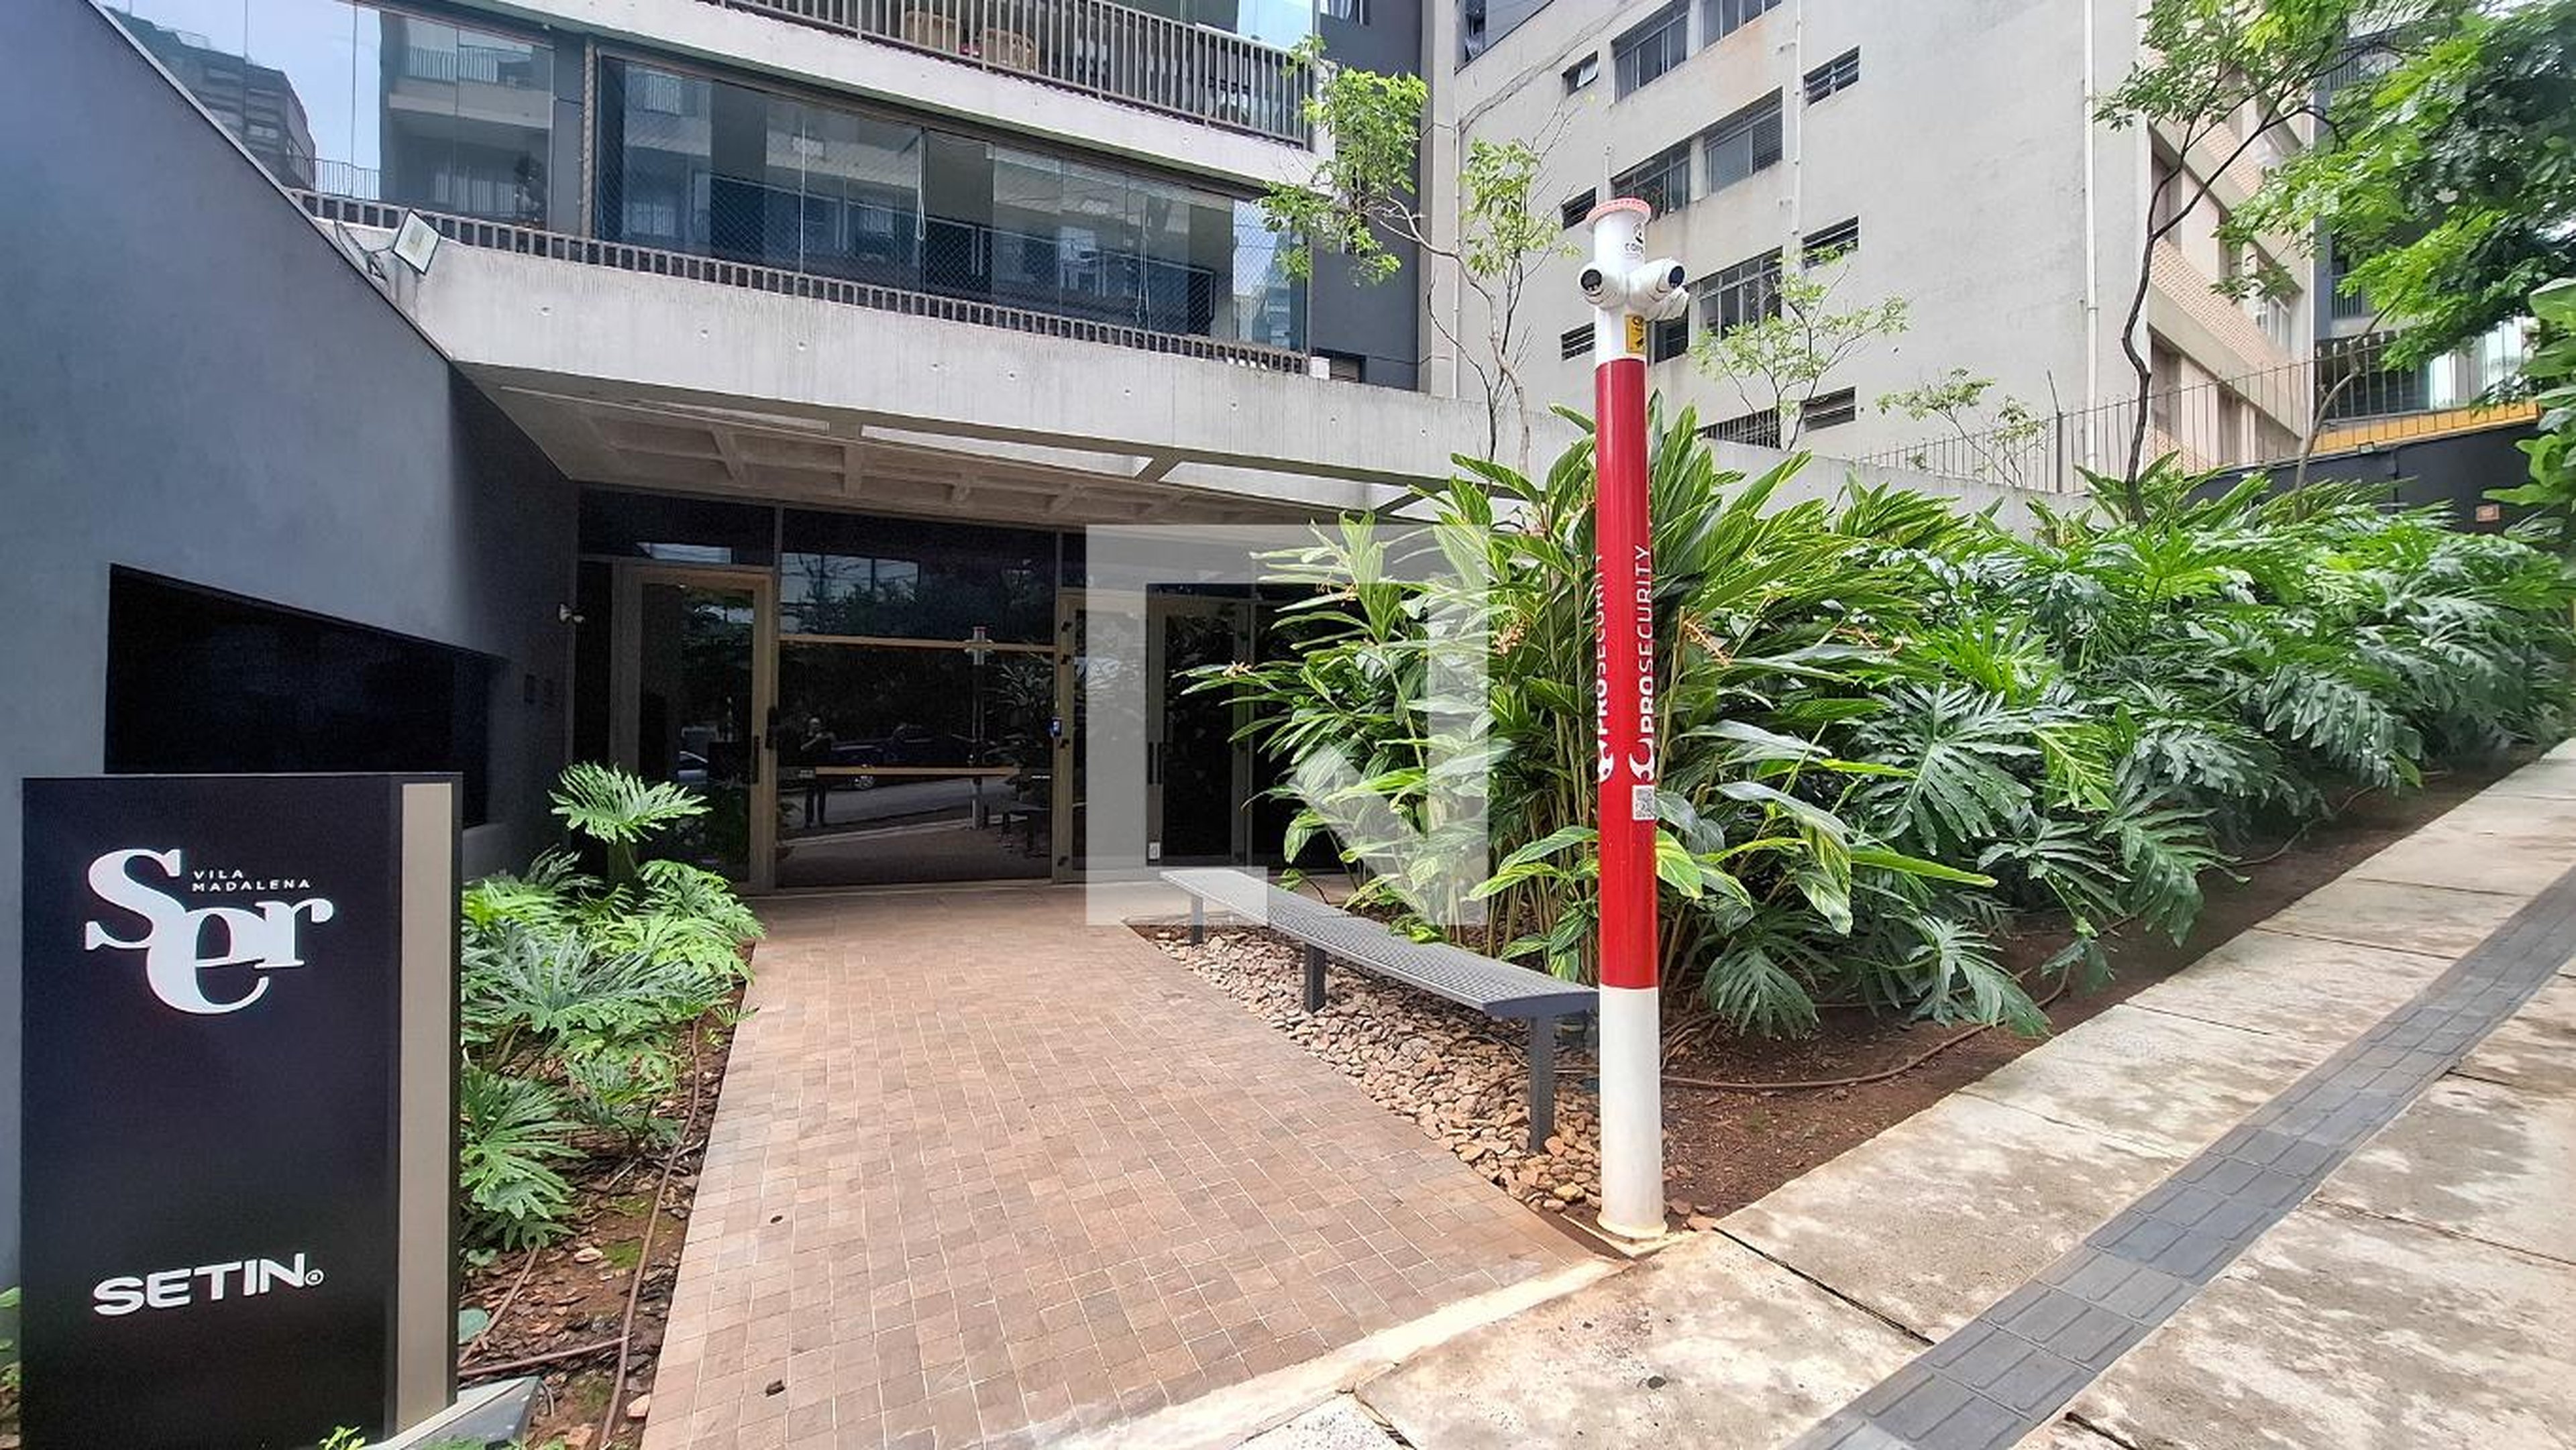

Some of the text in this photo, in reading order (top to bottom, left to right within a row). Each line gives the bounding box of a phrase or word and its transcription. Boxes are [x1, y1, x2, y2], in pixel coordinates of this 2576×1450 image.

[1635, 545, 1654, 734] PROSECURITY
[192, 879, 311, 892] MADALENA
[193, 869, 244, 880] VILA
[85, 848, 334, 1014] Ser
